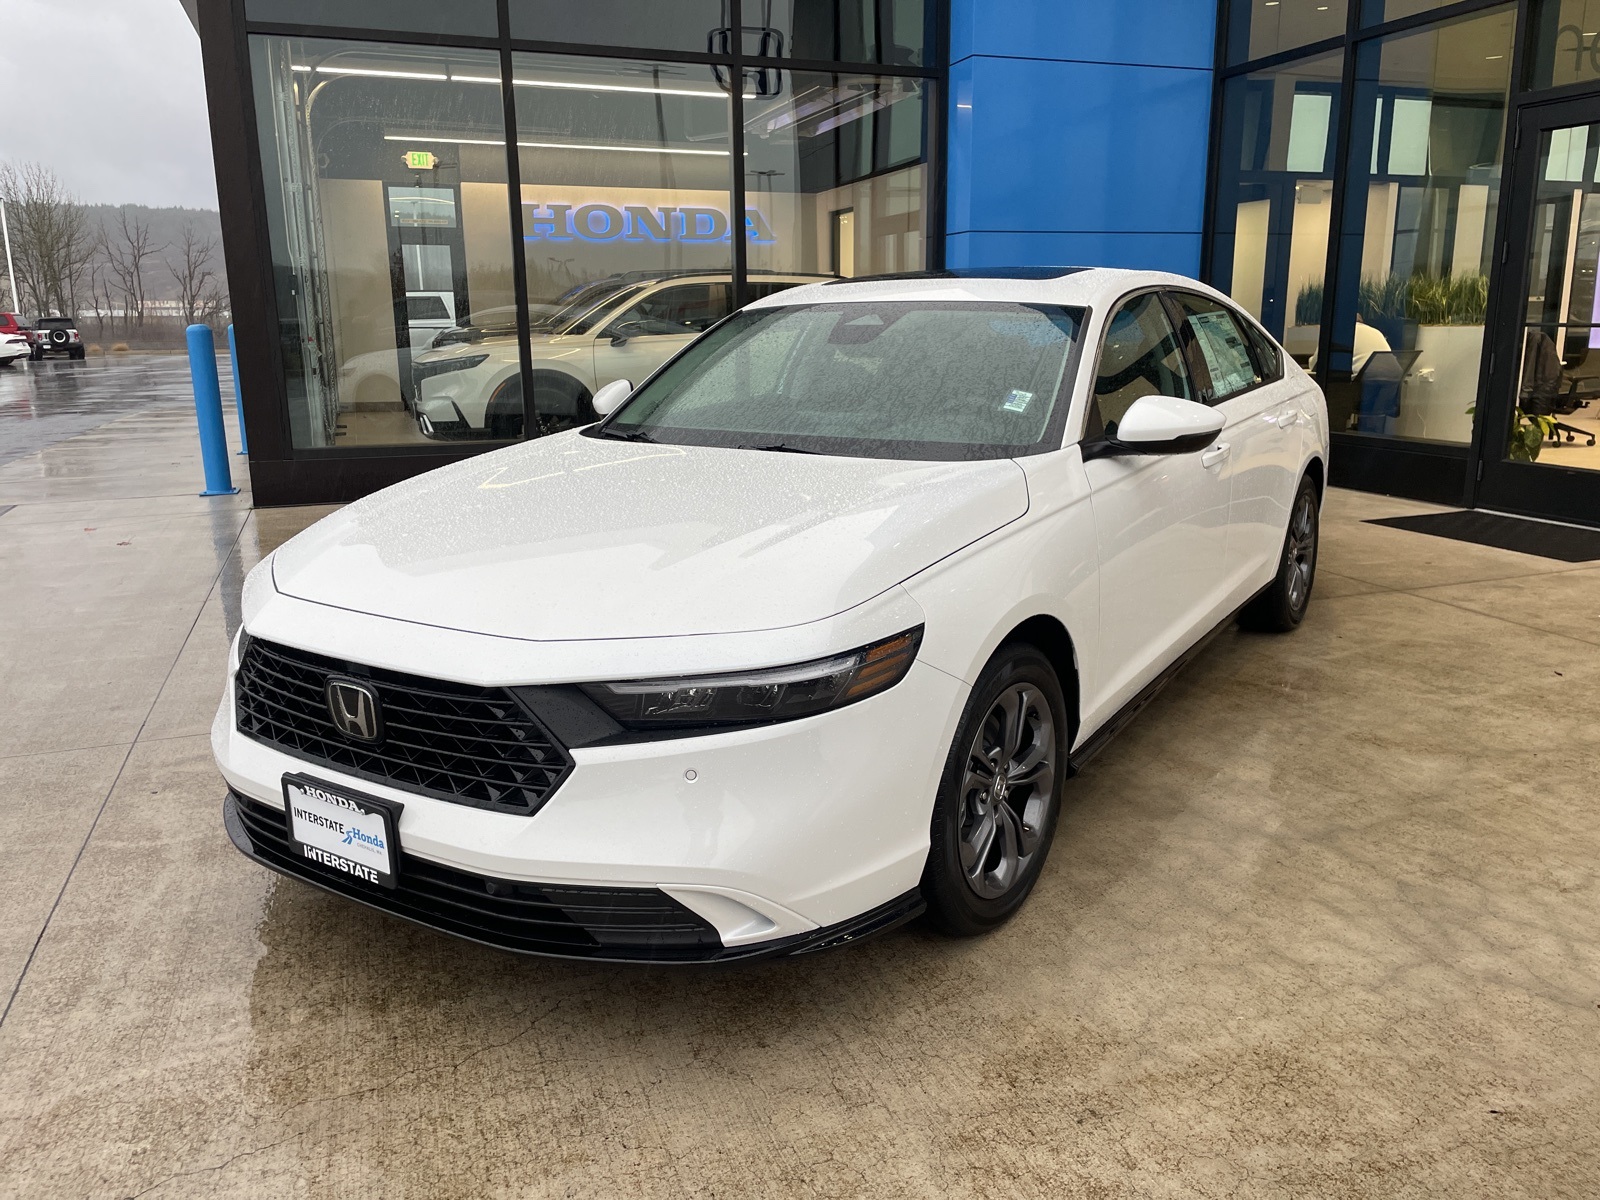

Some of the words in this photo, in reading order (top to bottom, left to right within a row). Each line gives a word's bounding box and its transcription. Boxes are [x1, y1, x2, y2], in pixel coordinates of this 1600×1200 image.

[412, 152, 429, 166] EXIT
[521, 203, 777, 242] HONDA
[303, 785, 361, 815] HONDA
[293, 806, 345, 835] INTERSTATE
[351, 826, 385, 850] Honda
[303, 844, 379, 885] INTERSTATE
